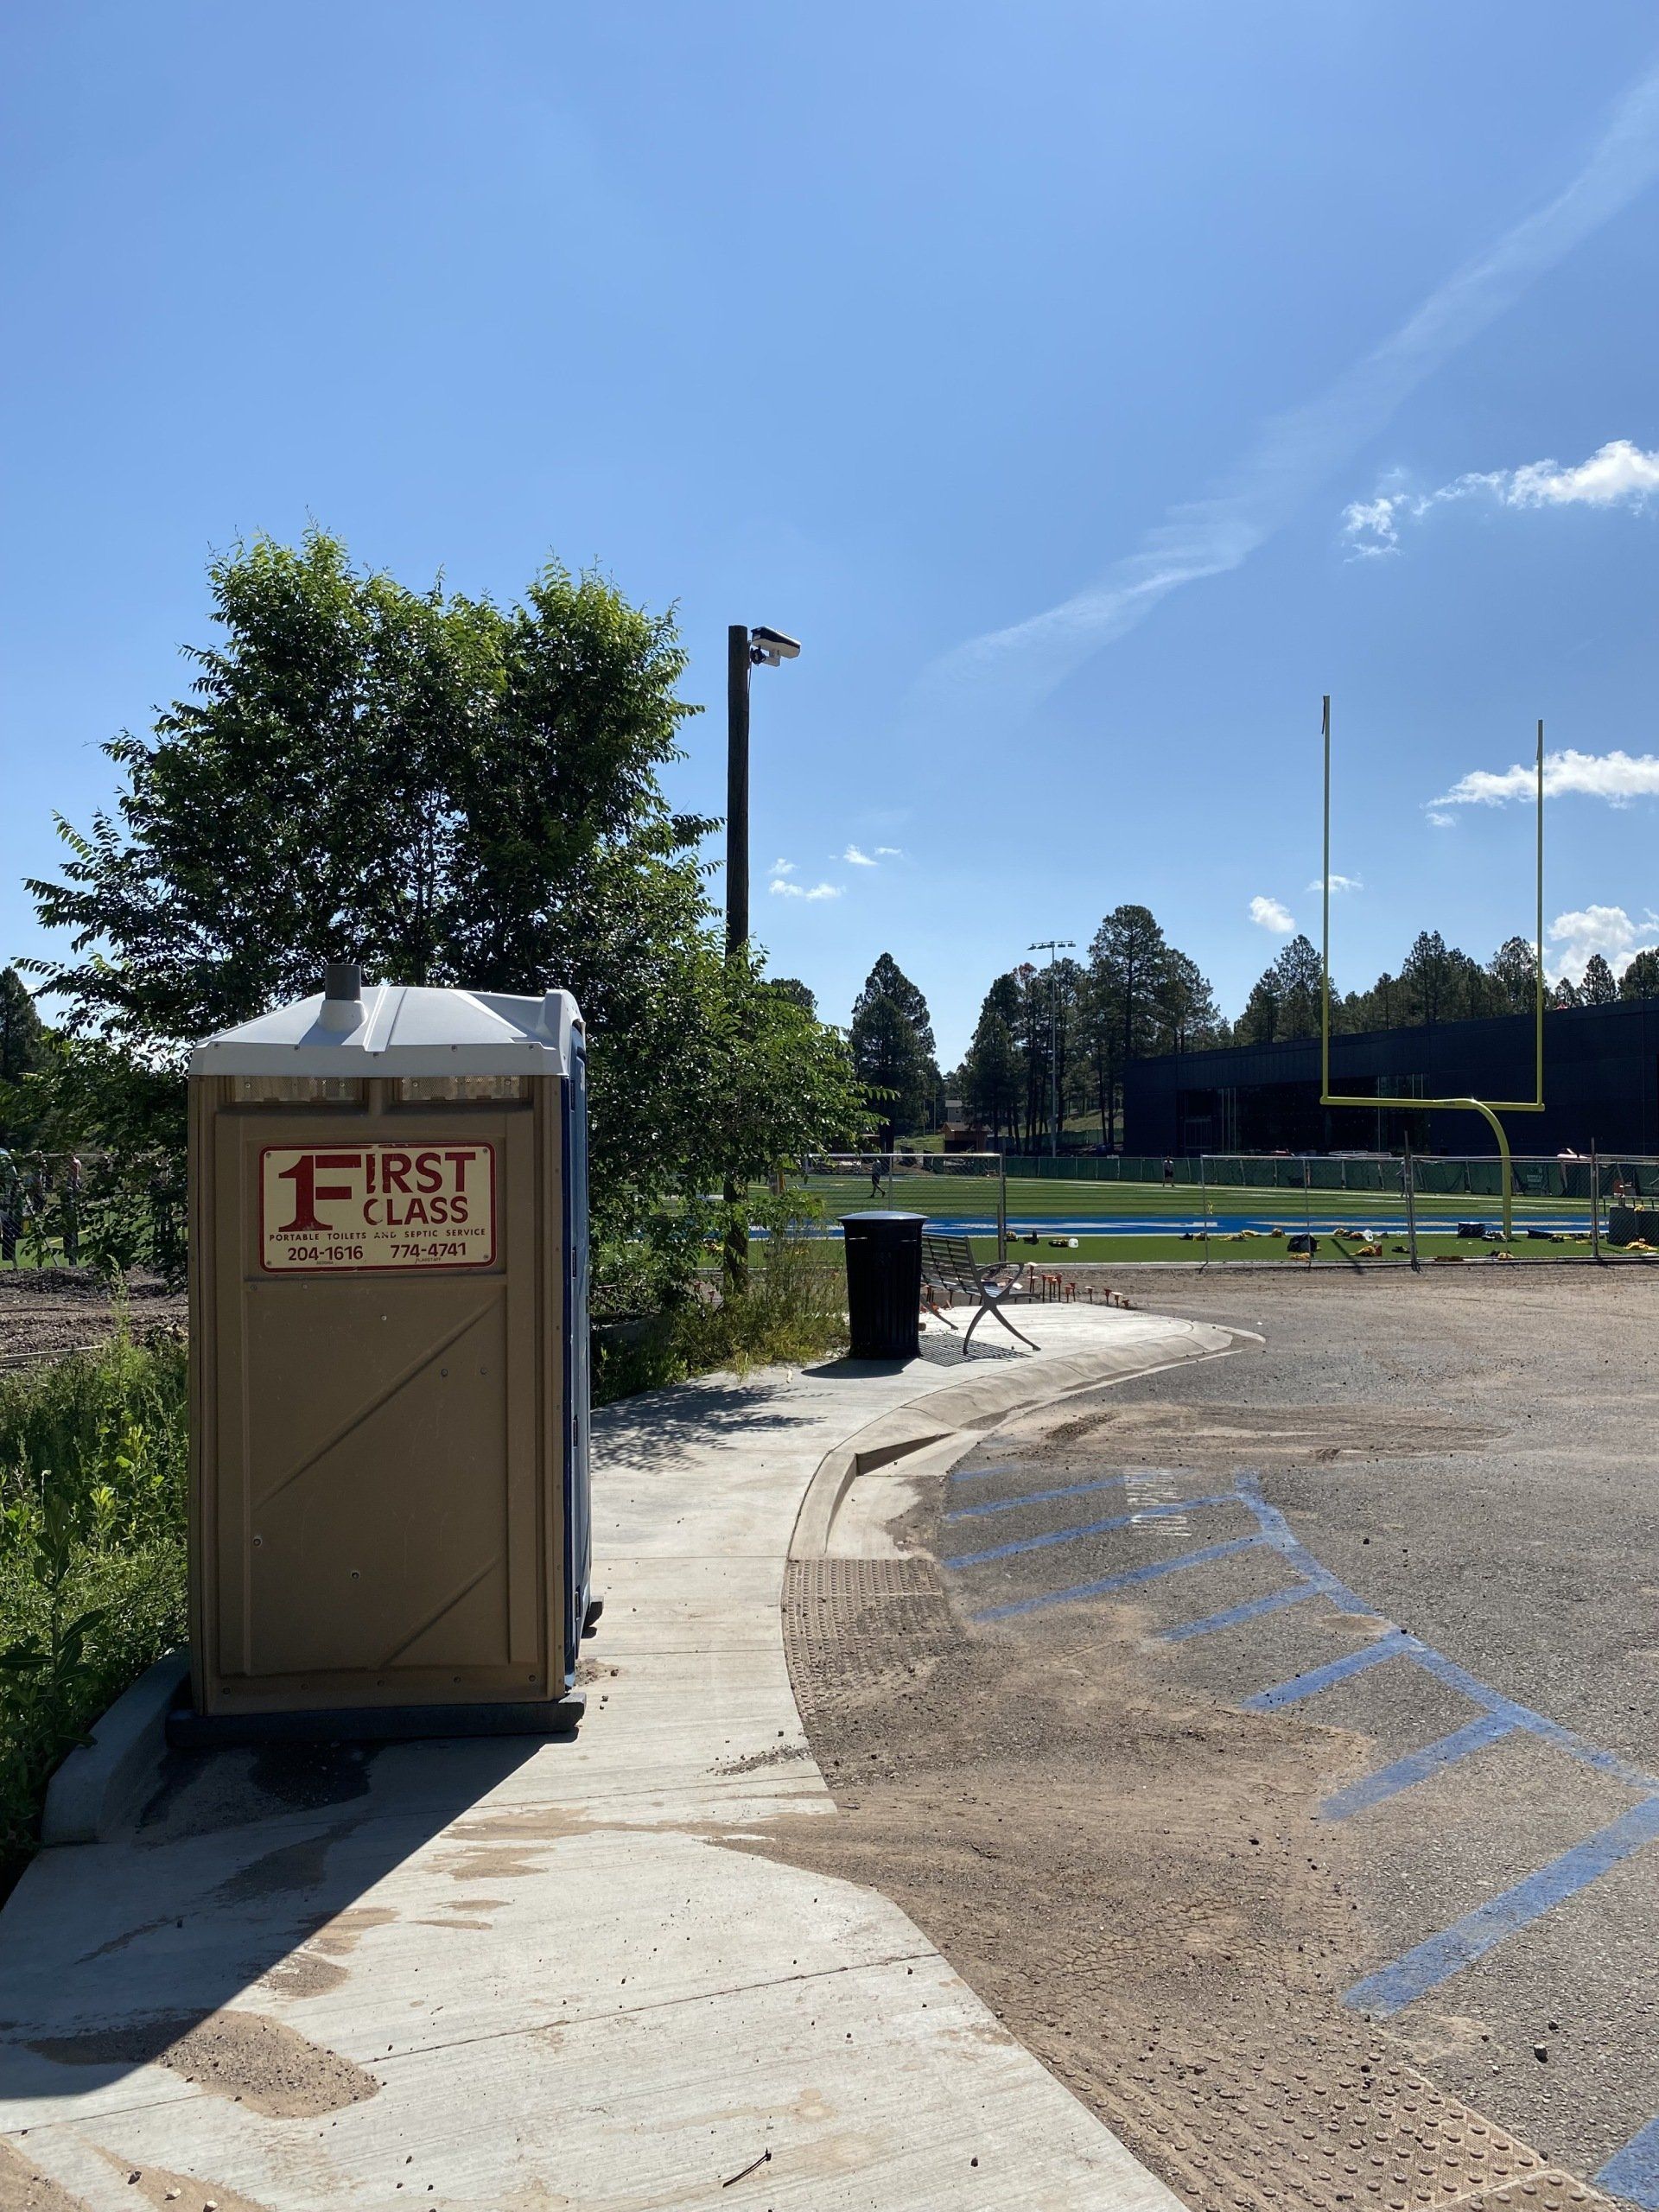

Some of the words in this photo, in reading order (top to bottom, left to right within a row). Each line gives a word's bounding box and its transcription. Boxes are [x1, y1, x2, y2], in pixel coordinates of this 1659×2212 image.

[363, 1196, 468, 1225] CLASS
[270, 1233, 319, 1242] PORTABLE
[327, 1231, 366, 1240] TOILETS
[404, 1230, 437, 1238] SEPTIC
[446, 1228, 486, 1236] SERVICE
[288, 1245, 363, 1261] 204-1616
[390, 1242, 466, 1258] 774-4741
